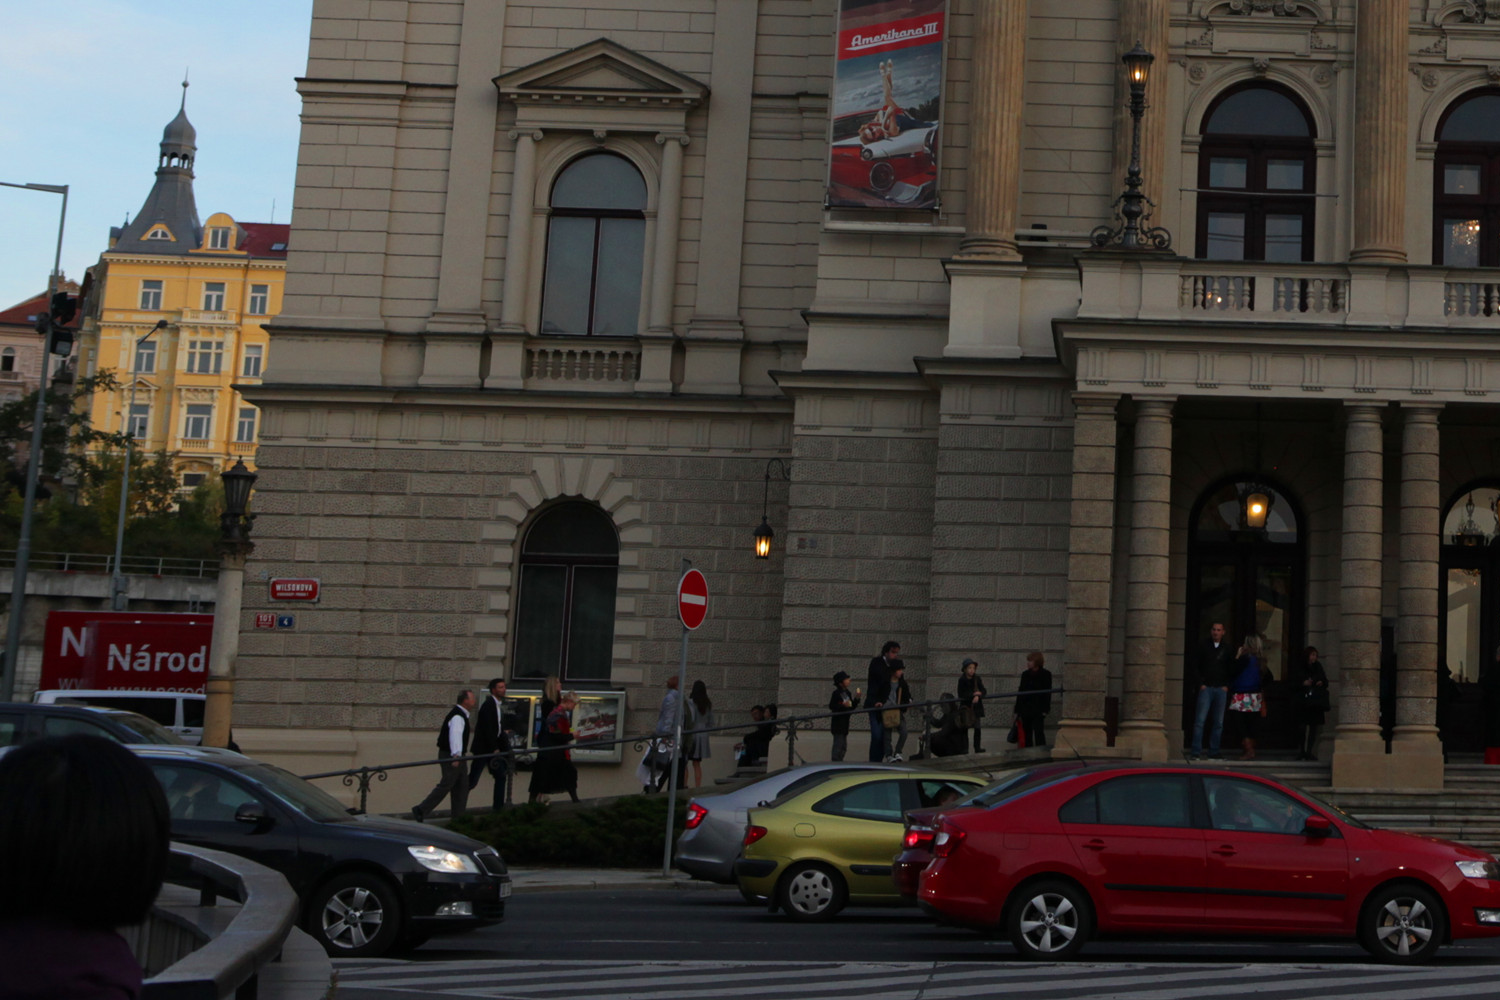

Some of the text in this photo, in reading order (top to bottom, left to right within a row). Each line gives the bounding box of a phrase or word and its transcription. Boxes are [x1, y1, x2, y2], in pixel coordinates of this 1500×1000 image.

[852, 22, 939, 46] Amerikana III
[275, 583, 313, 592] WILSONOVA
